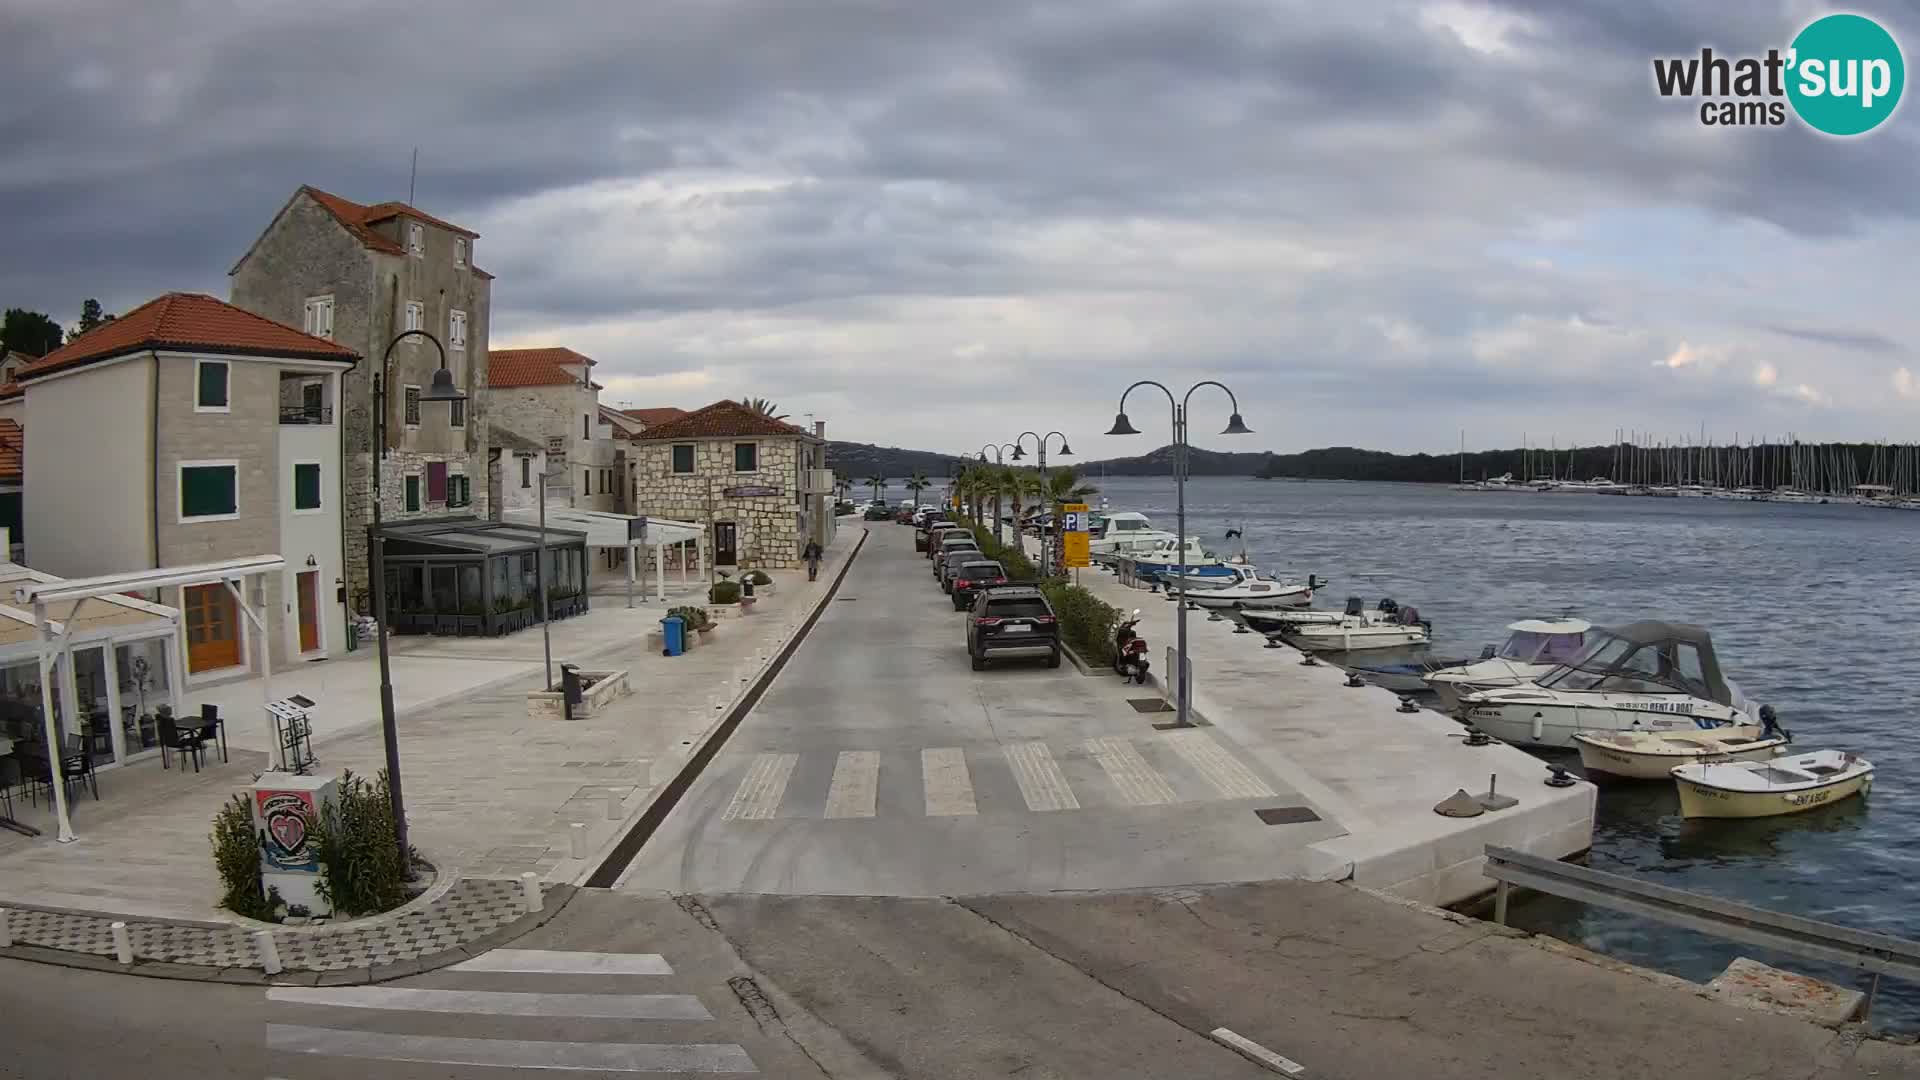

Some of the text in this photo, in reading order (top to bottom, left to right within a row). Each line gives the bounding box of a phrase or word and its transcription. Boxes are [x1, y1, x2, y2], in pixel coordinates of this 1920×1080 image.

[1066, 514, 1076, 530] P
[1649, 702, 1668, 712] RENT
[1675, 703, 1694, 713] BOAT
